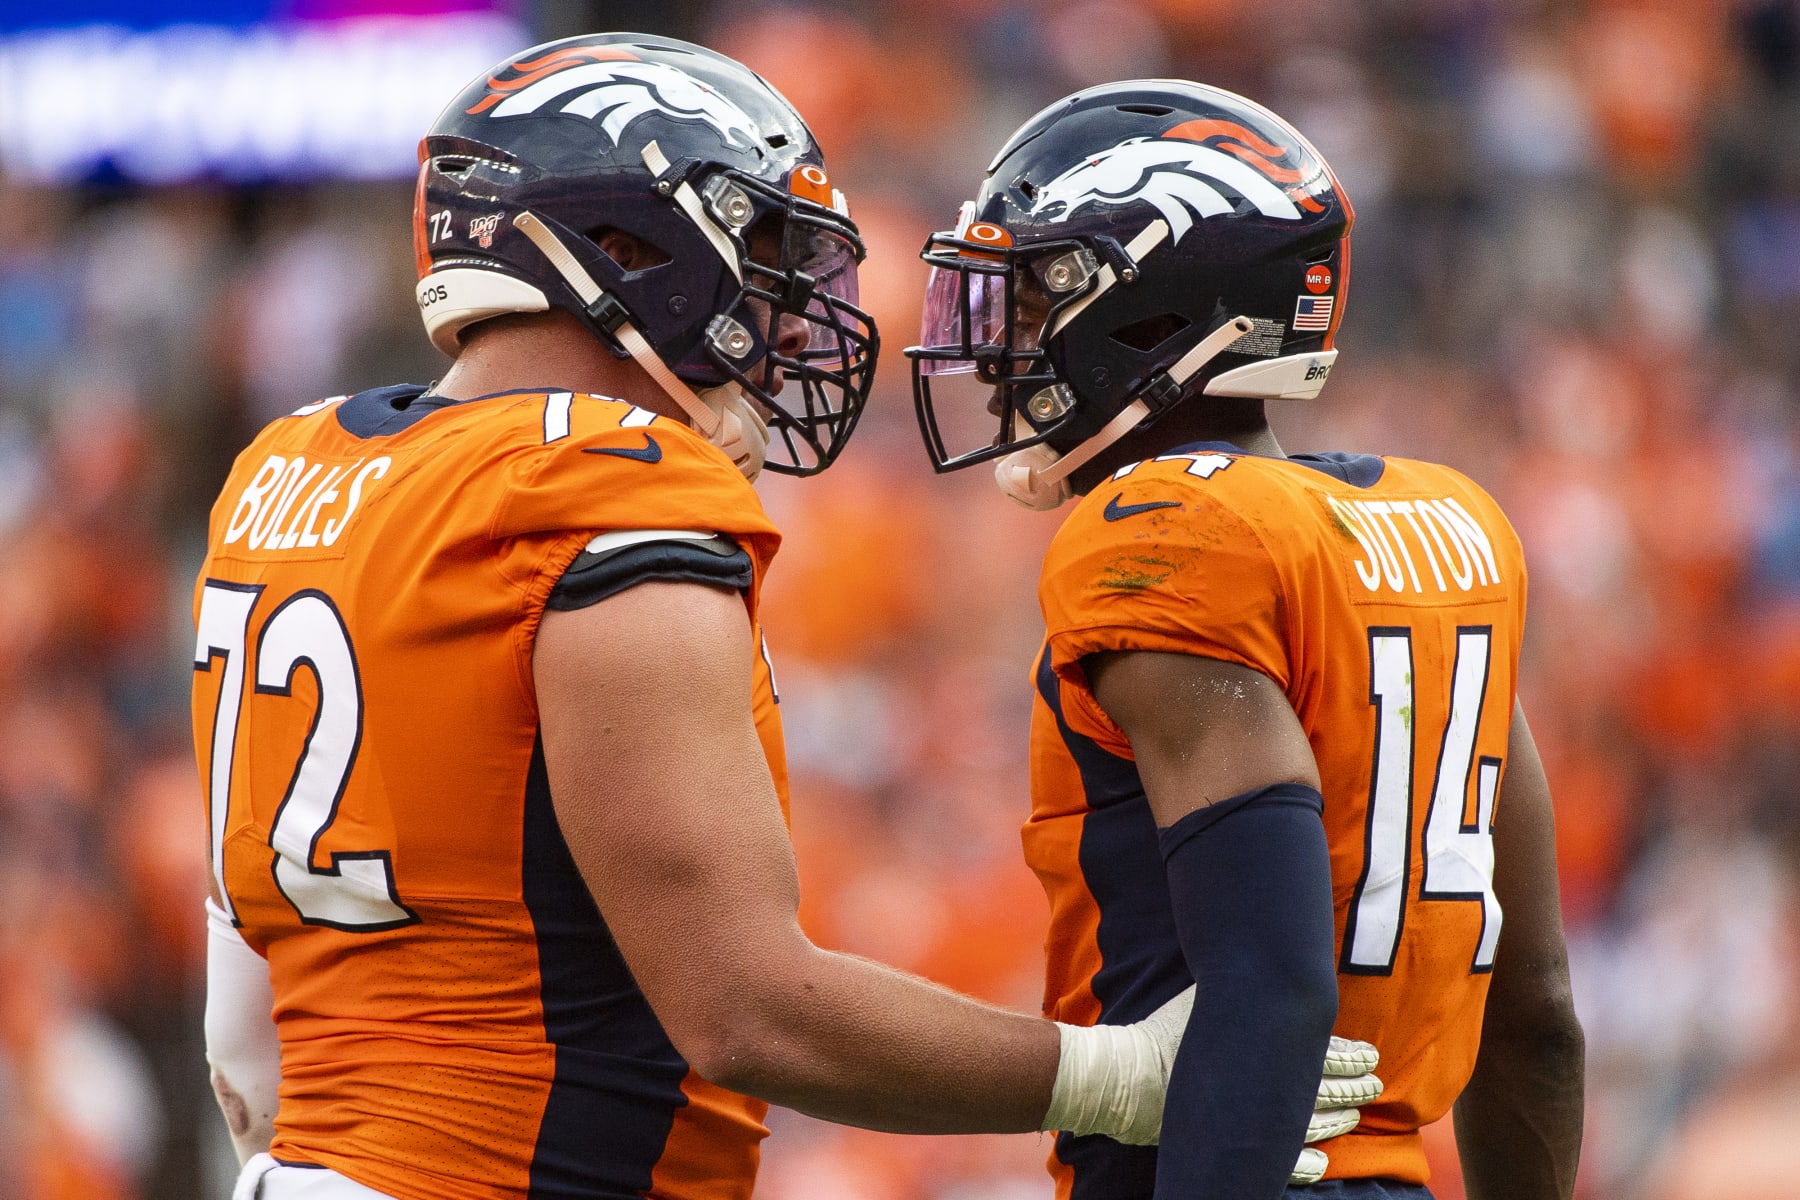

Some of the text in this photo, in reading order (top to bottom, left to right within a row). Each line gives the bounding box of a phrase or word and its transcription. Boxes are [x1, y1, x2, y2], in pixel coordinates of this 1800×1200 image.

[430, 210, 453, 244] 72
[1307, 274, 1331, 285] MR B
[223, 454, 392, 551] BOLLES
[1326, 496, 1501, 594] SUTTON
[193, 577, 423, 934] 72
[1337, 624, 1503, 977] 14
